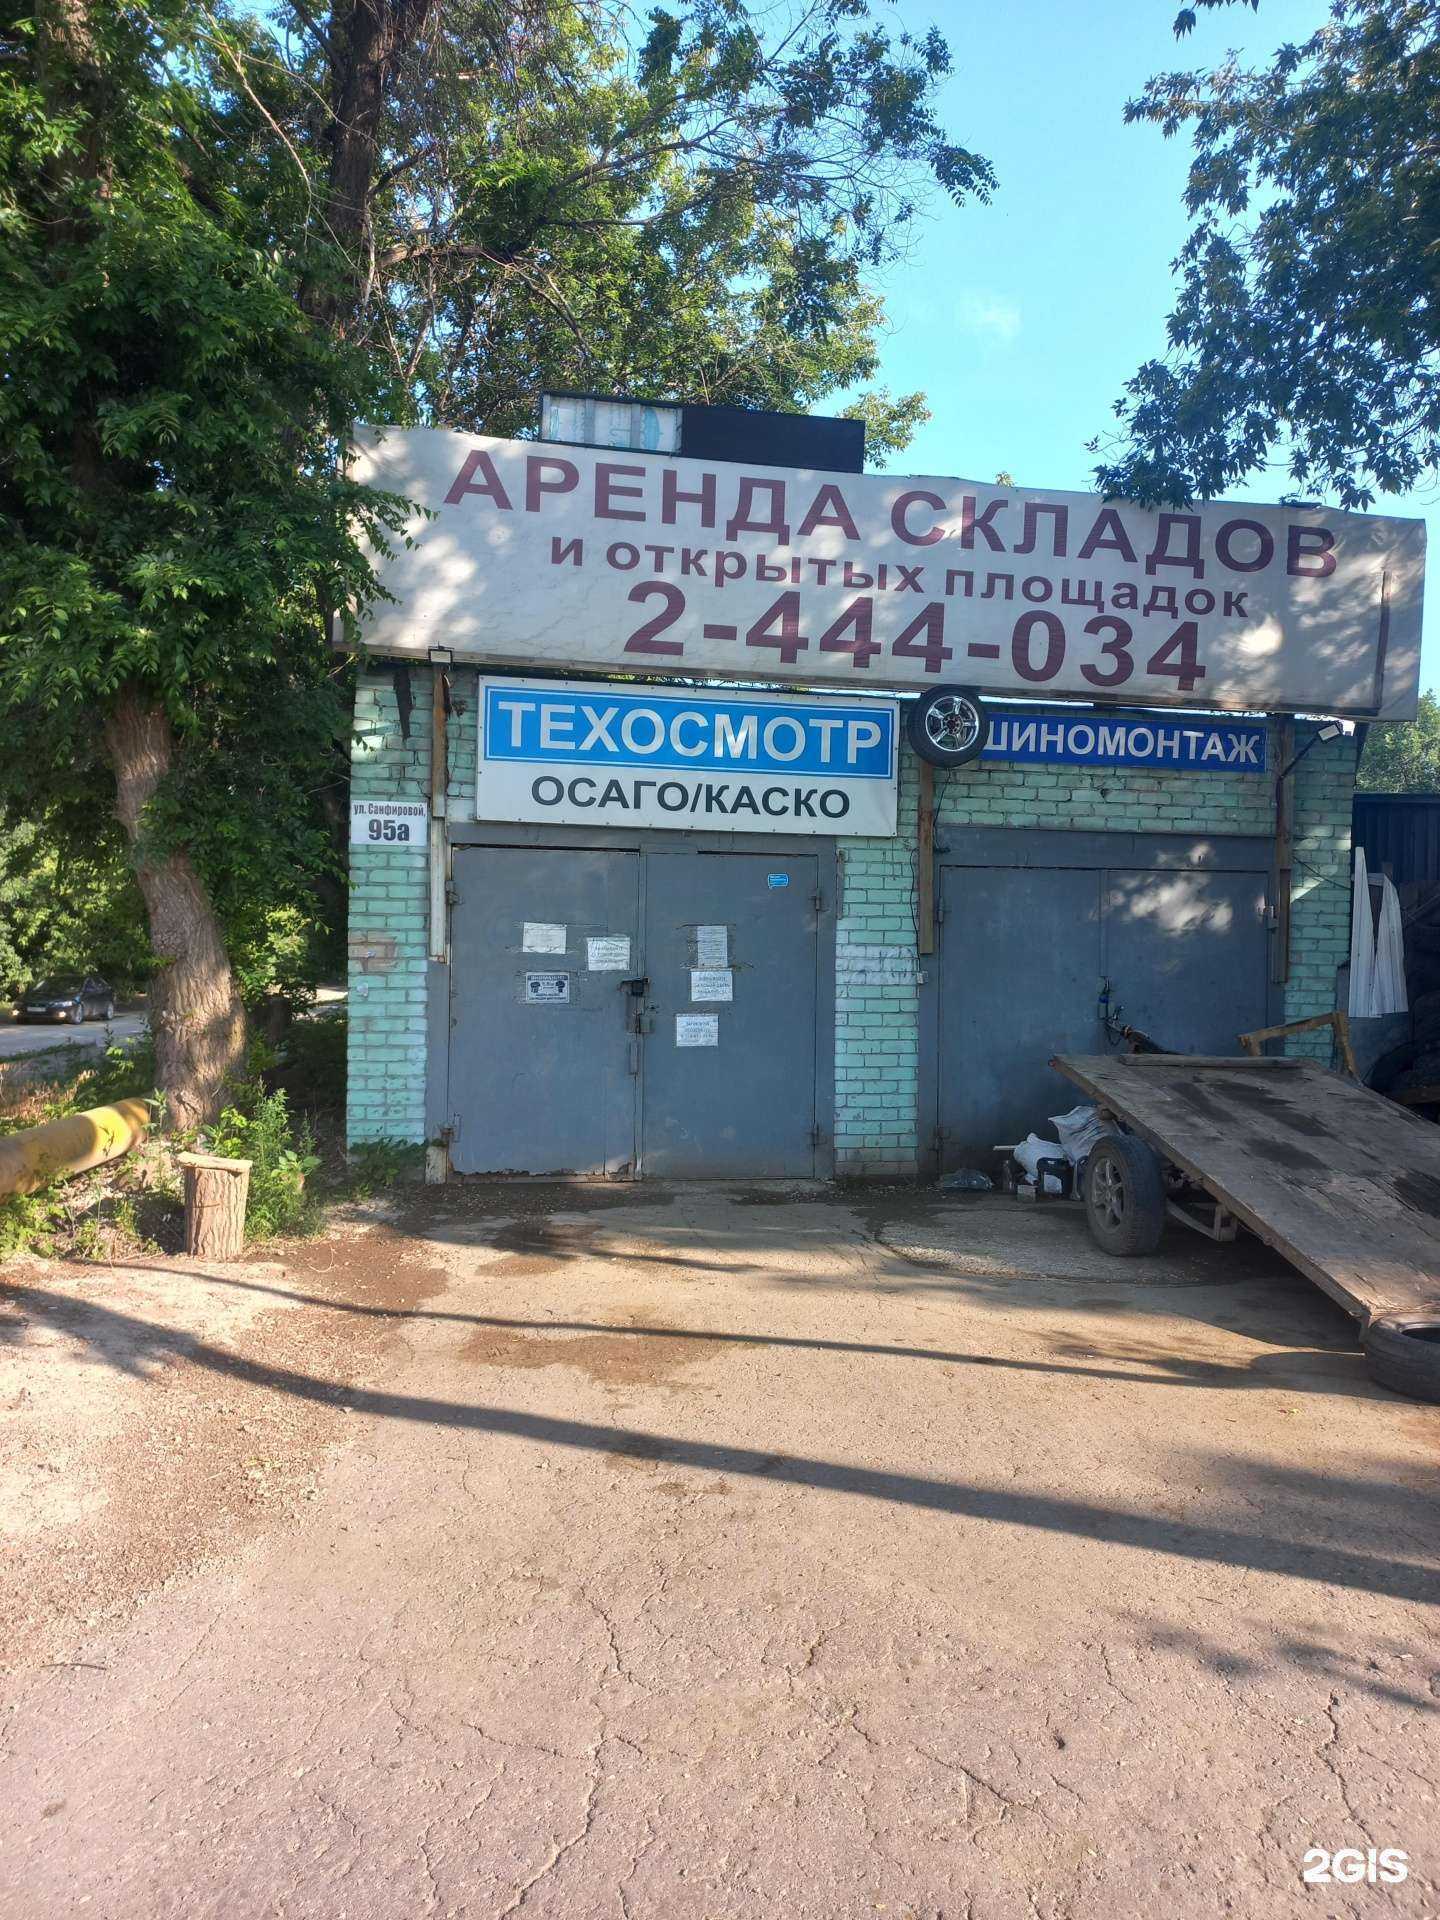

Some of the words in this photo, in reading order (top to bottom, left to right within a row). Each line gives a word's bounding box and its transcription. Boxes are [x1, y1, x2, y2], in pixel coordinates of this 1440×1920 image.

[443, 449, 861, 546] АРЕНДА
[890, 490, 1337, 579] СКЛАДОВ
[551, 536, 583, 567] и
[605, 541, 925, 594] открытых
[945, 568, 1249, 619] площадок
[624, 580, 1206, 691] 2-444-034
[497, 701, 882, 764] ТЕХОСМОТР
[984, 720, 1259, 764] ШИНОМОНТАЖ
[353, 804, 367, 815] ул.
[530, 775, 851, 819] ОСАГО/КАСКО
[368, 819, 410, 842] 95а
